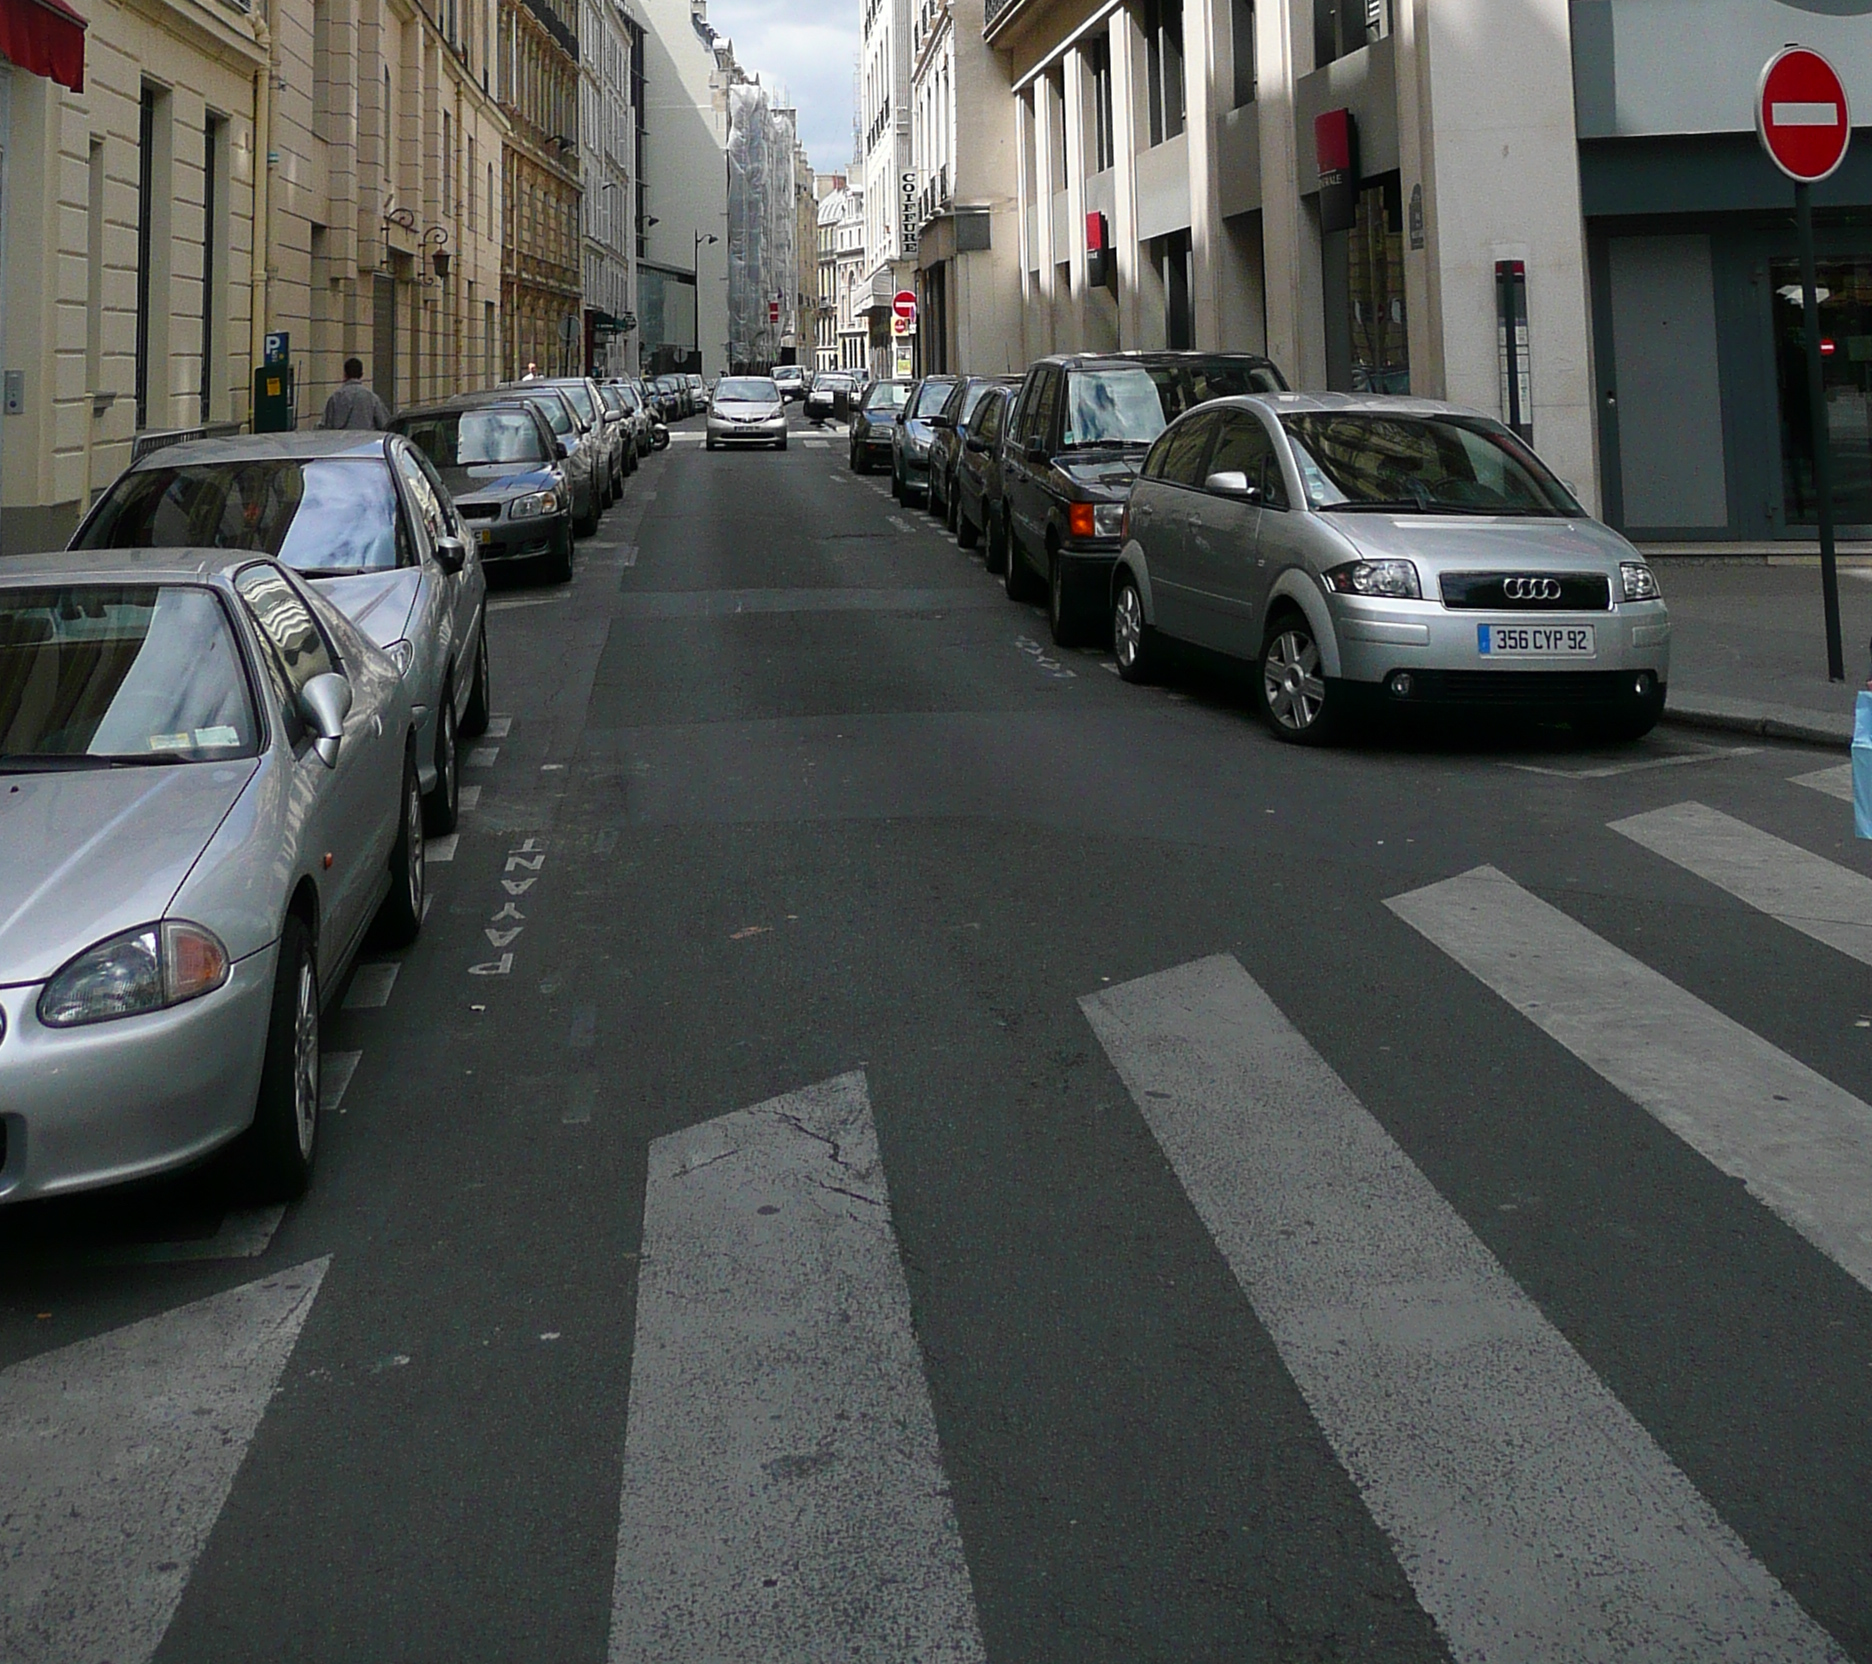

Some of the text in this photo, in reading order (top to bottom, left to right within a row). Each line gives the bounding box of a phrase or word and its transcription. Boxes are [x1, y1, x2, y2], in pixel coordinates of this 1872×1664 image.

[902, 173, 917, 252] COIFFURE
[265, 335, 280, 354] P
[1496, 630, 1587, 649] 356 CYP 92
[468, 838, 546, 974] PAYANT
